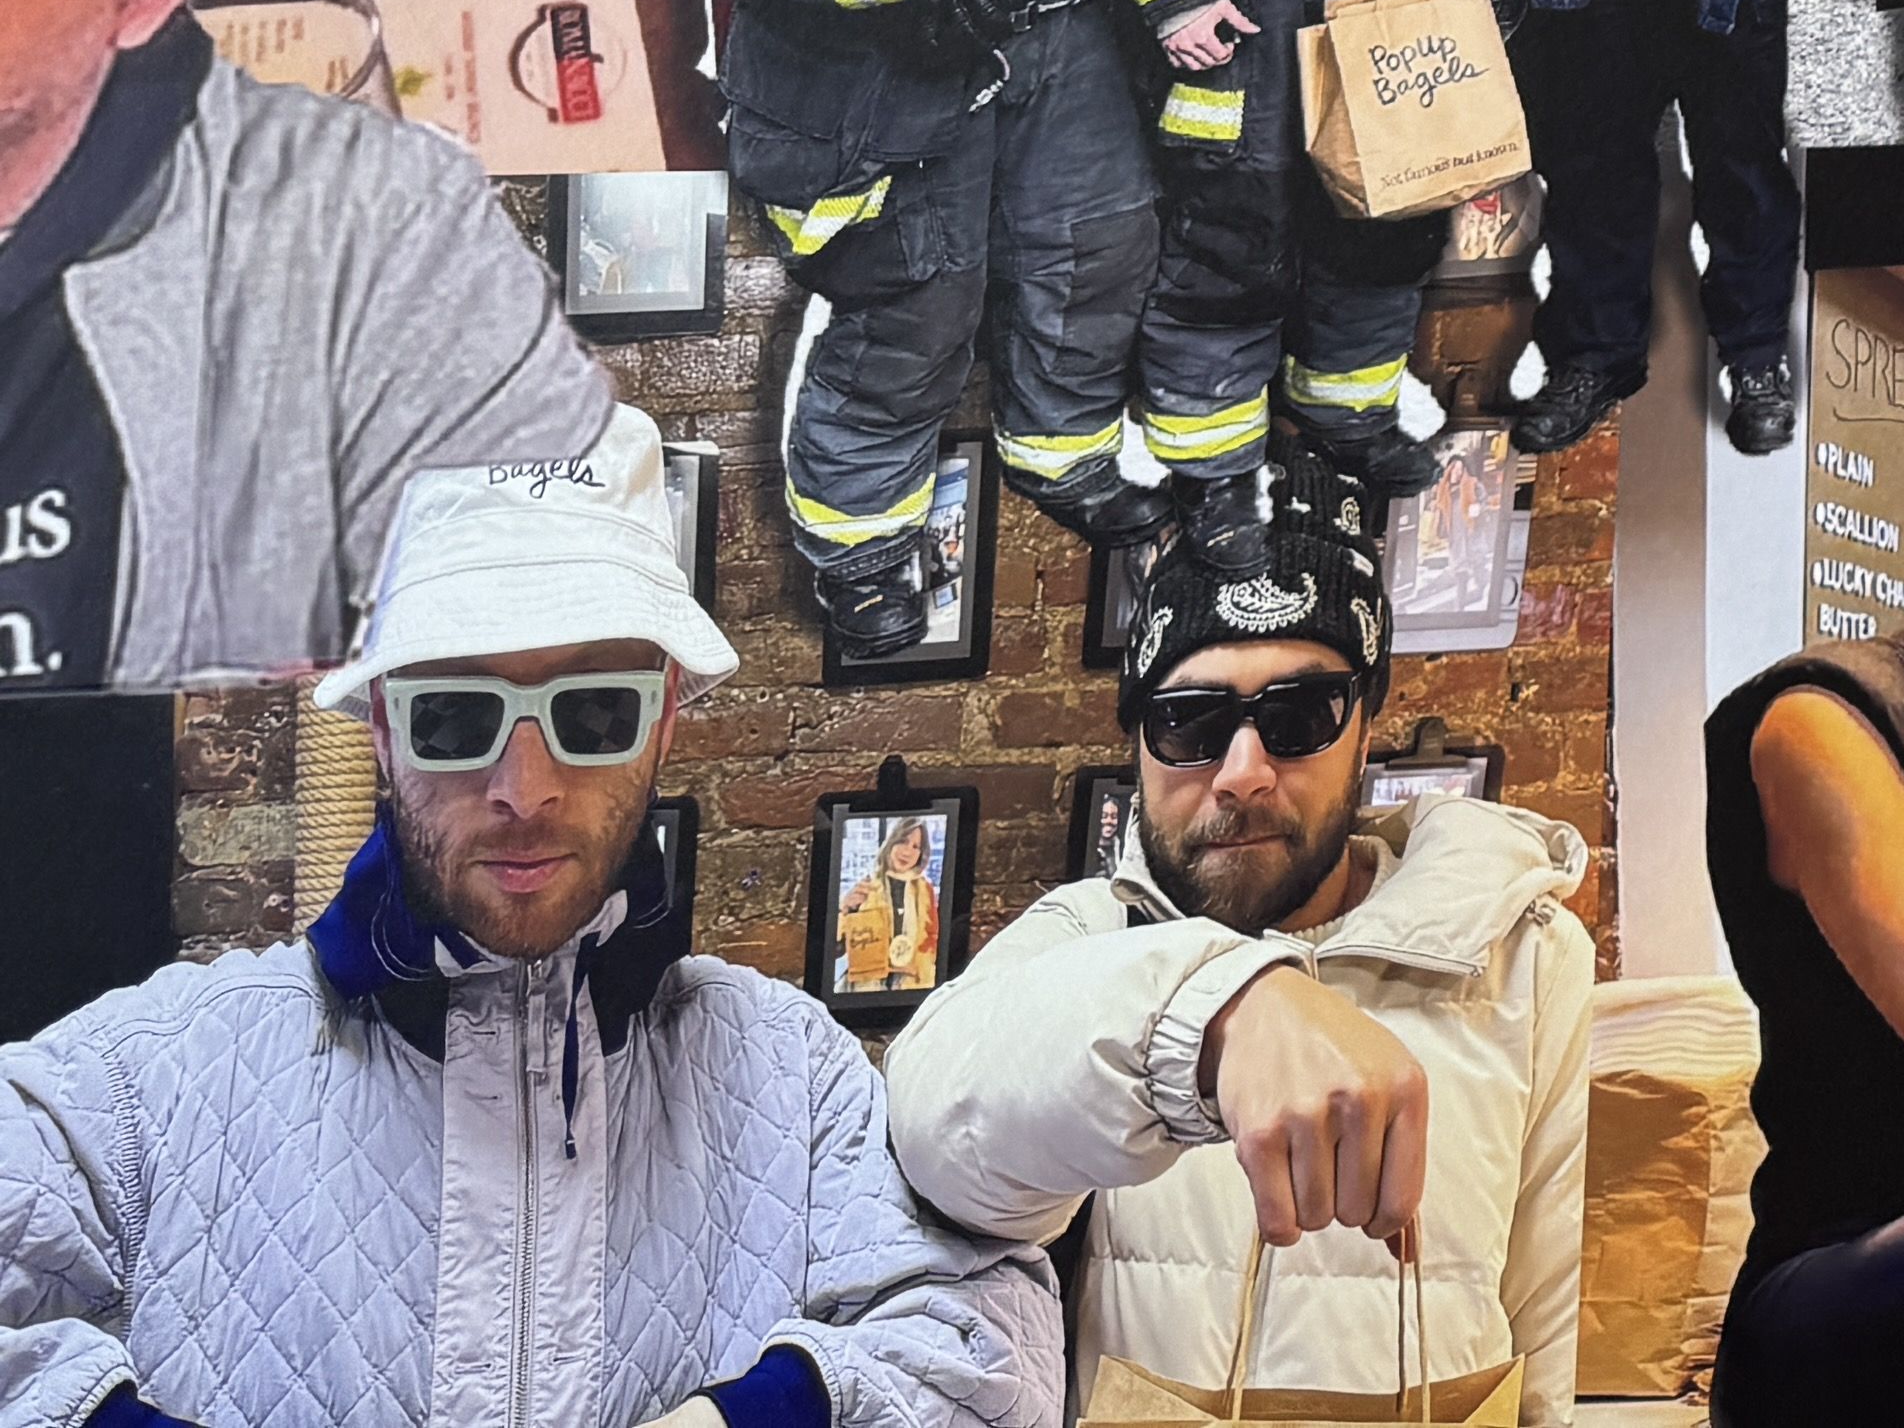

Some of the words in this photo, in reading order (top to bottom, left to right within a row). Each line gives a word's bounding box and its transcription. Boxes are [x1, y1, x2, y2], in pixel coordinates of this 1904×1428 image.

[1372, 56, 1490, 108] Bagels
[1826, 451, 1875, 488] PLAIN
[1824, 503, 1899, 553] SCALLION
[1822, 558, 1875, 598] LUCKY
[1818, 603, 1877, 640] BUTTER
